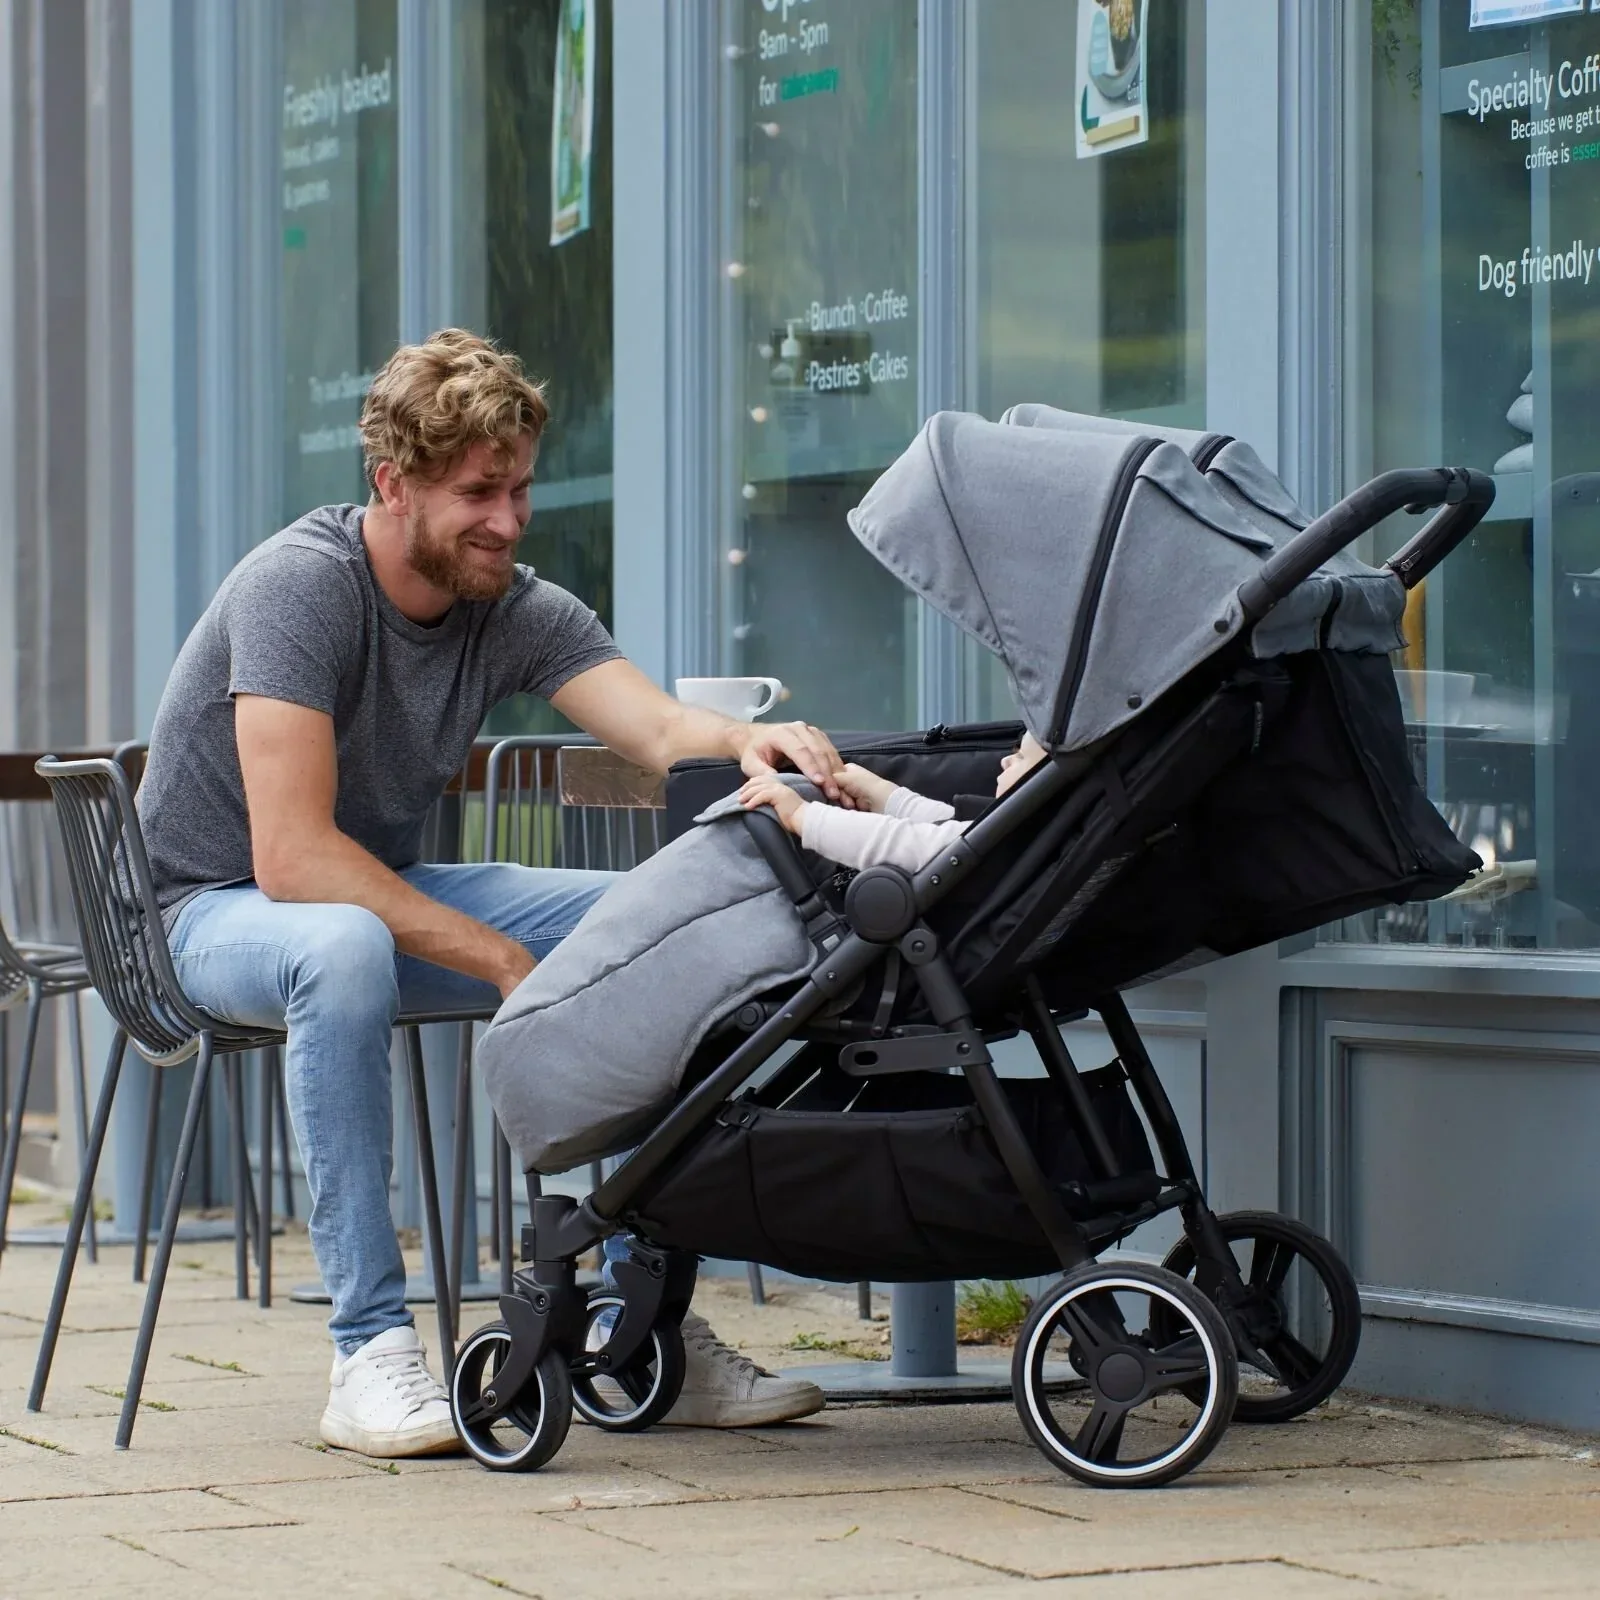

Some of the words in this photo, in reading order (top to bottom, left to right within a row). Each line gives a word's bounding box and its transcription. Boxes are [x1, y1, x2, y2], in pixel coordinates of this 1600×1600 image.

[759, 29, 788, 60] 9am
[800, 19, 829, 56] 5pm
[759, 75, 777, 107] for
[1467, 68, 1553, 122] Specialty
[1558, 54, 1600, 98] Coff
[1511, 117, 1555, 140] Because
[1558, 114, 1573, 131] we
[1575, 106, 1593, 134] get
[1525, 145, 1558, 170] coffee
[1561, 142, 1570, 163] is
[1479, 254, 1516, 298] Dog
[1521, 240, 1594, 285] friendly
[811, 296, 856, 332] Brunch
[865, 288, 909, 324] Coffee
[810, 354, 860, 391] Pastries
[869, 350, 909, 384] Cakes
